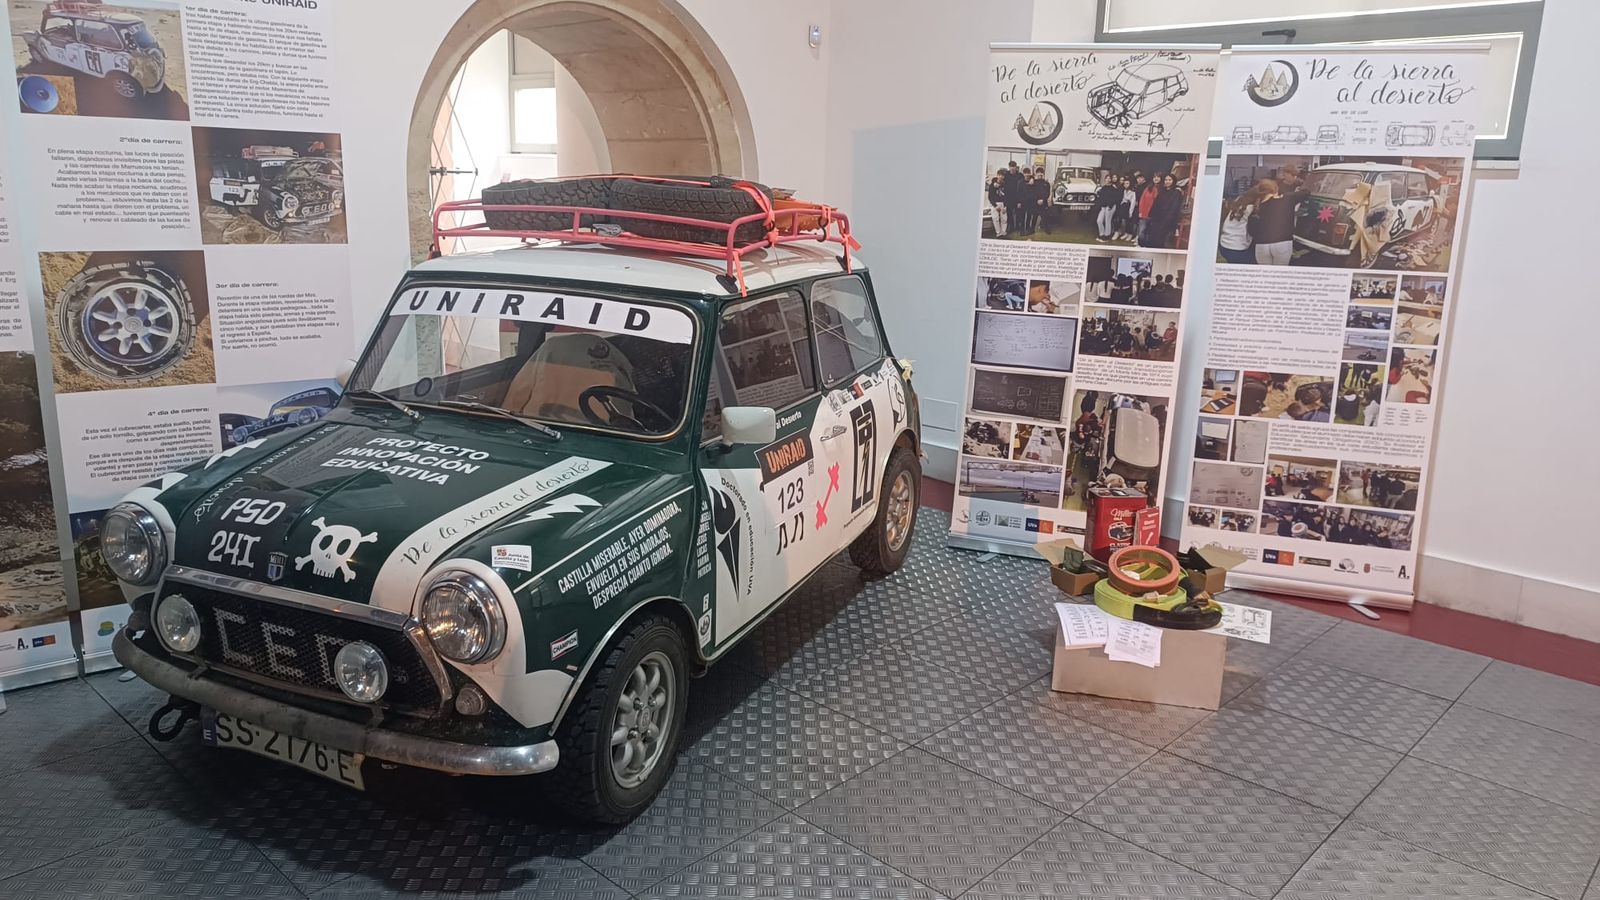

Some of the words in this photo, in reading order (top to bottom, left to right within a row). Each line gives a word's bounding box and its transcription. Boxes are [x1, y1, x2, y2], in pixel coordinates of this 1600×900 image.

[992, 64, 1016, 82] De
[1026, 60, 1040, 76] la
[1048, 52, 1097, 72] sierra
[1306, 58, 1340, 80] De
[1352, 59, 1373, 80] la
[1384, 64, 1454, 80] sierra
[1001, 84, 1016, 103] al
[1024, 71, 1095, 101] desierto
[1337, 81, 1363, 102] al
[1371, 80, 1475, 104] desierto
[409, 290, 650, 331] UNIRAID
[781, 410, 801, 427] Desierto
[336, 447, 480, 474] INNOVACIÓN
[366, 437, 490, 460] PROYECTO
[320, 458, 450, 485] EDUCATIVA
[721, 477, 747, 511] Doctorado
[778, 477, 804, 514] 123
[402, 540, 432, 565] De
[439, 527, 458, 540] la
[464, 500, 512, 528] sierra
[513, 488, 531, 501] al
[536, 460, 590, 493] desierto
[558, 562, 593, 594] CASTILLA
[591, 537, 631, 571] MISERABLE,
[628, 525, 646, 546] AYER
[643, 501, 682, 534] DOMINADORA,
[586, 563, 619, 595] ENVUELTA
[618, 556, 627, 573] EN
[626, 547, 640, 566] SUS
[640, 526, 671, 557] ANDRAJOS,
[592, 575, 629, 610] DESPRECIA
[628, 557, 651, 584] CUANTO
[650, 543, 673, 567] IGNORA.
[203, 728, 212, 740] E
